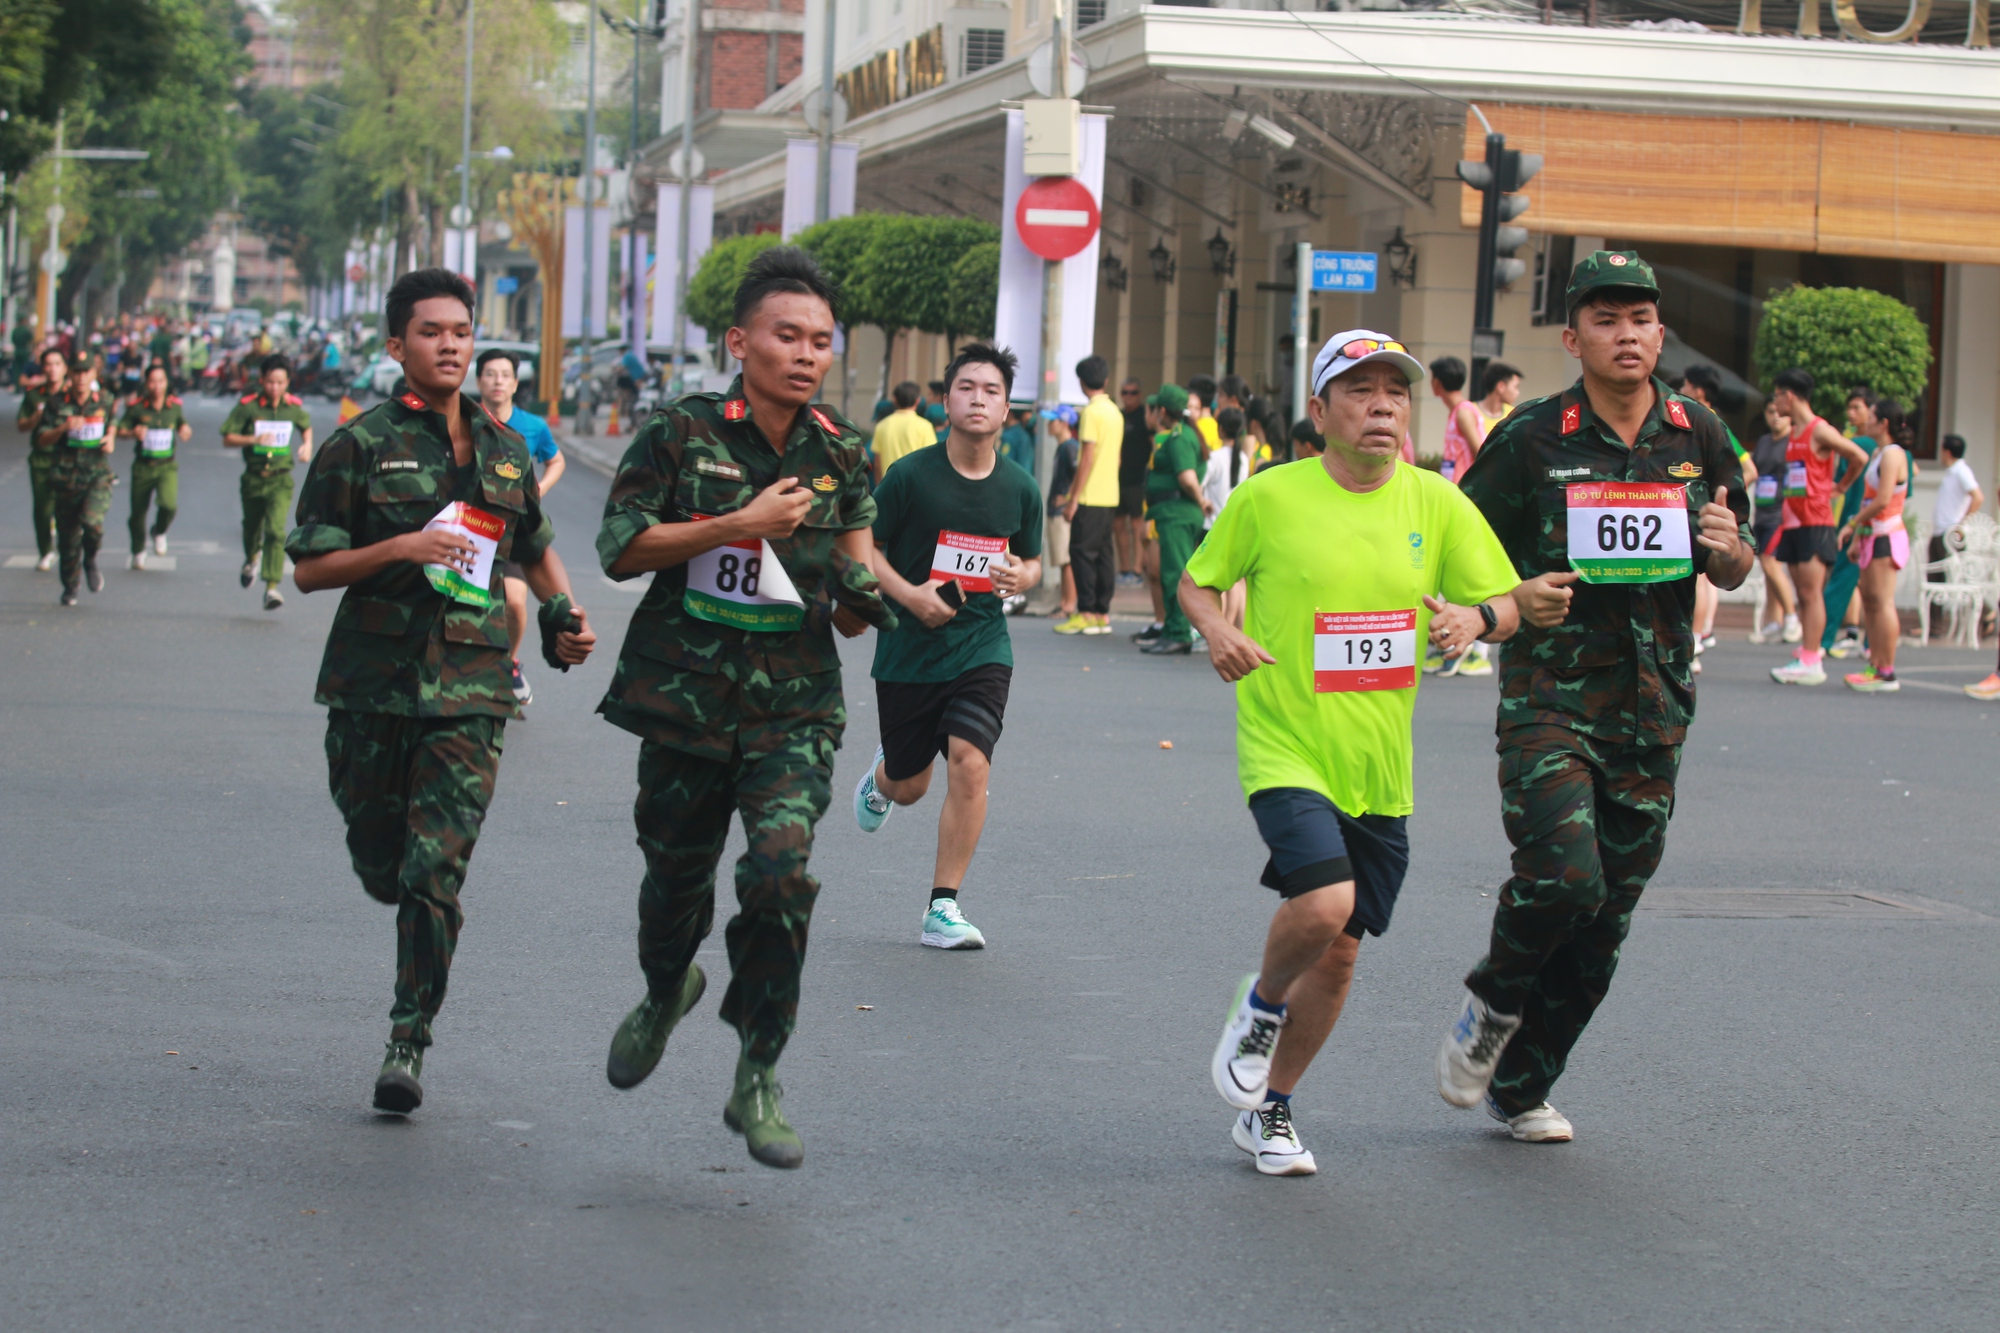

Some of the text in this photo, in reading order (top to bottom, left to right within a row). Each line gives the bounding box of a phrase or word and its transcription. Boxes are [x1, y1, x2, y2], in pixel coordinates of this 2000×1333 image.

[1323, 273, 1343, 286] LAM
[1573, 488, 1680, 502] BỘ TƯ LỆNH THÀNH PHỐ
[1597, 513, 1663, 553] 662
[955, 552, 990, 574] 167
[1603, 567, 1643, 578] 30/4/2023
[1344, 637, 1392, 665] 193
